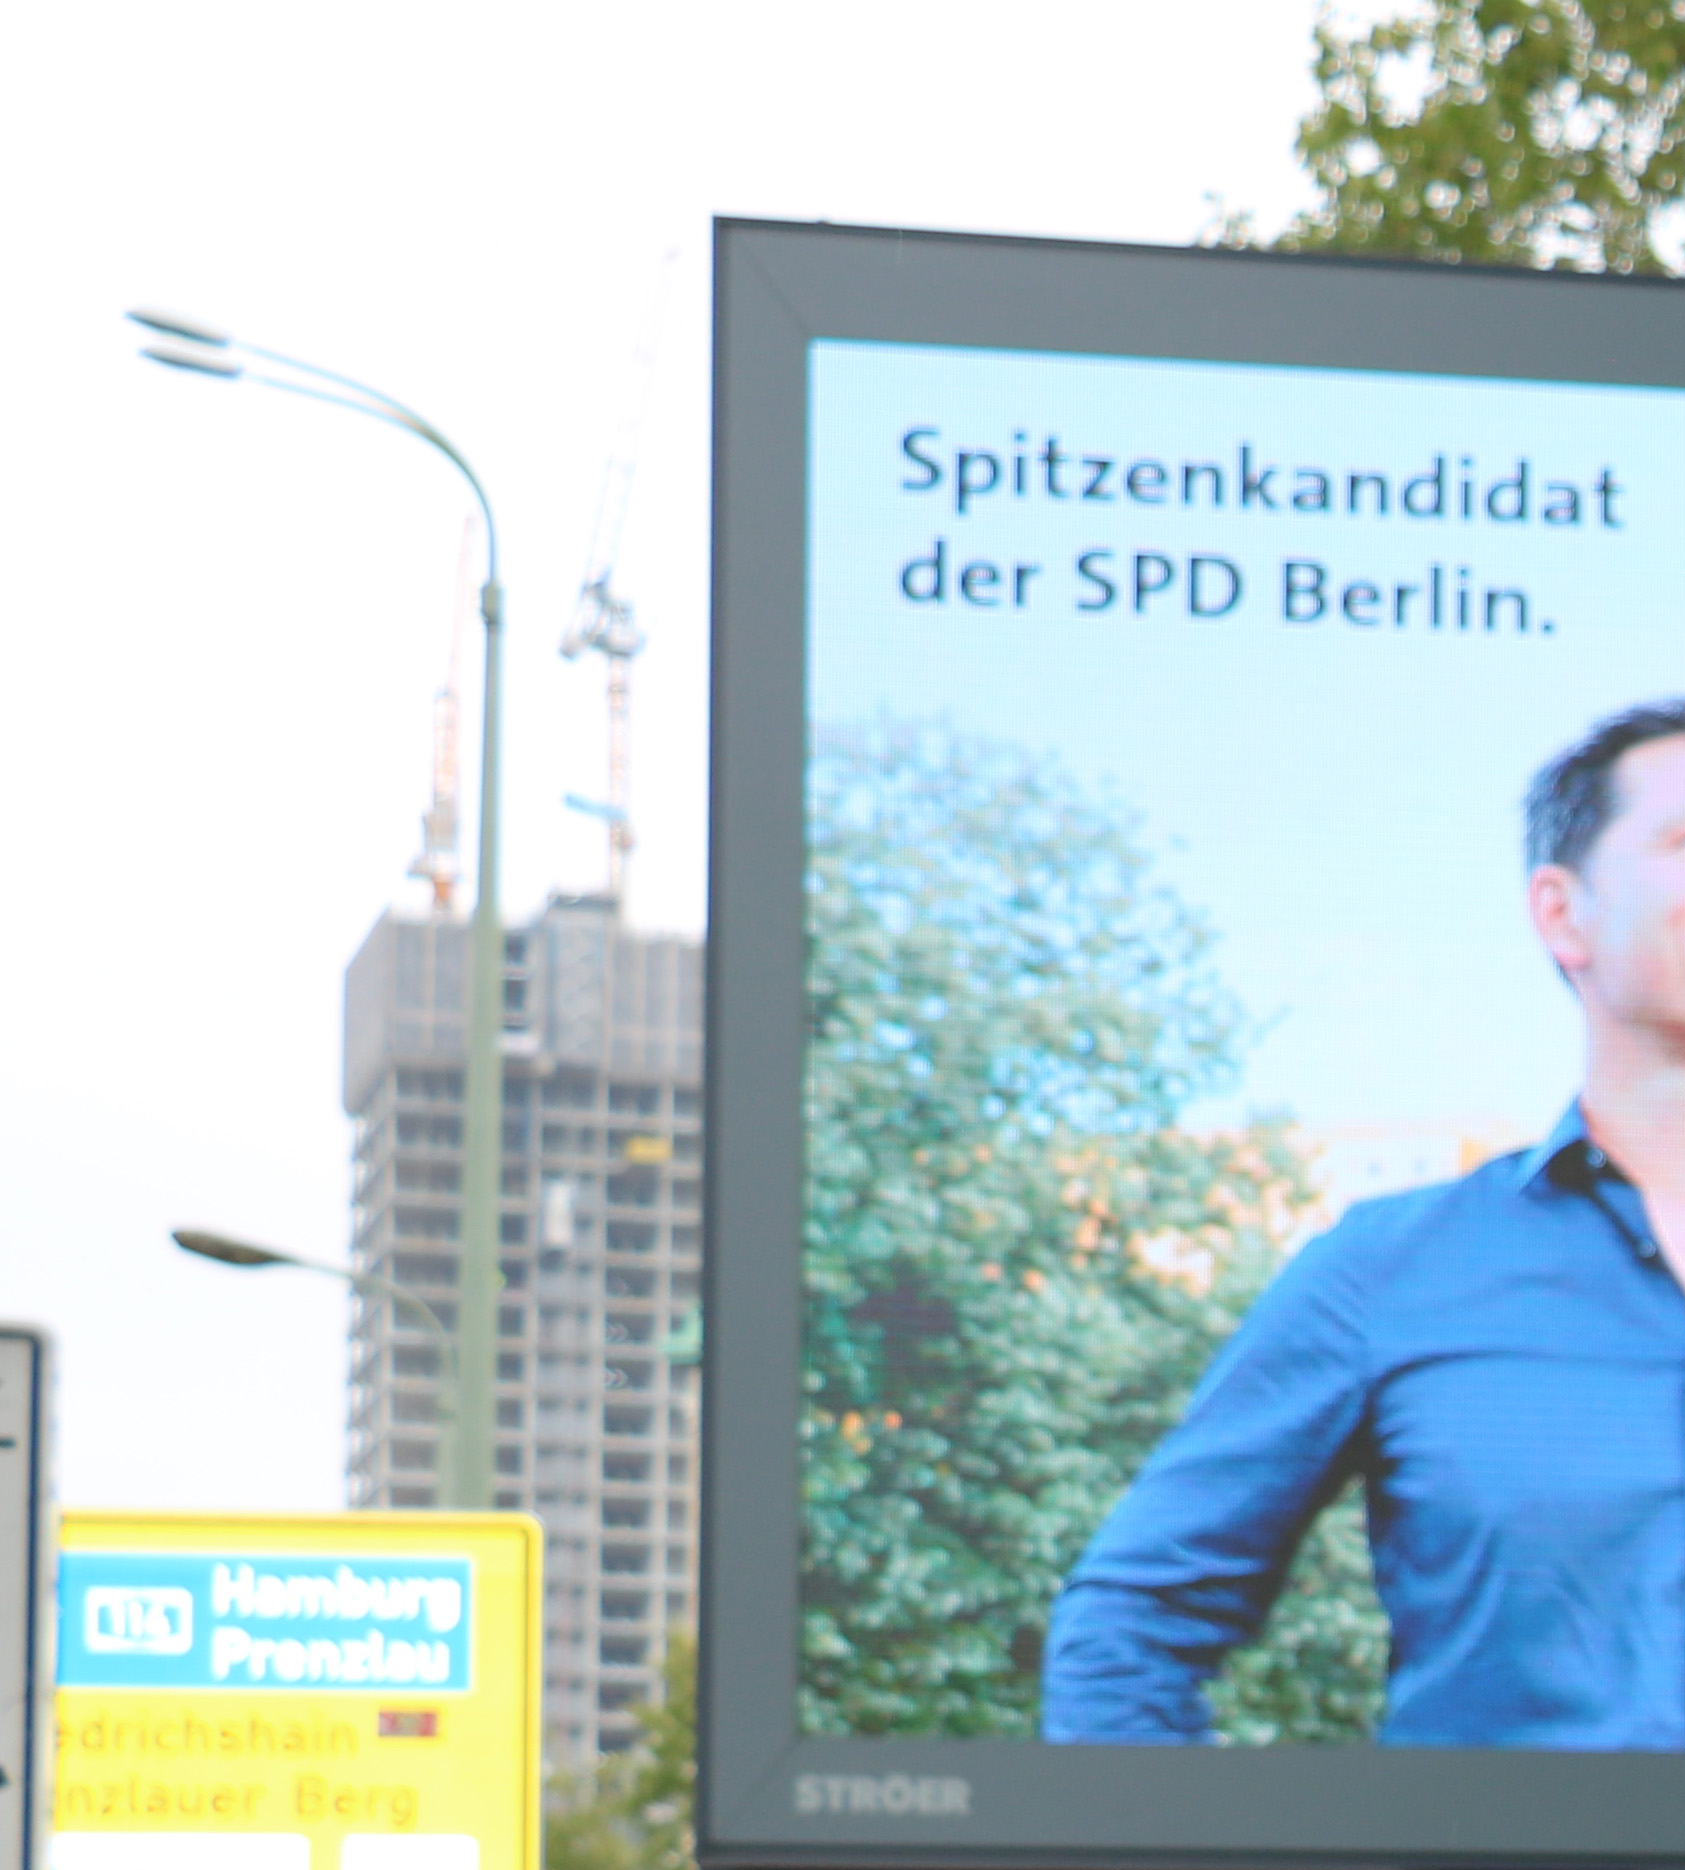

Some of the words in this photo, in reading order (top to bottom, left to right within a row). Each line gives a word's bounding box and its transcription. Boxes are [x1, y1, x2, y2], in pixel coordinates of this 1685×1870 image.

[900, 427, 1627, 530] Spitzenkandidat
[900, 535, 1042, 607] der
[1075, 547, 1245, 618] SPD
[1283, 558, 1559, 638] Berlin.
[211, 1561, 463, 1635] Hamburg
[211, 1625, 451, 1685] Prenzlau
[294, 1773, 415, 1830] Berg
